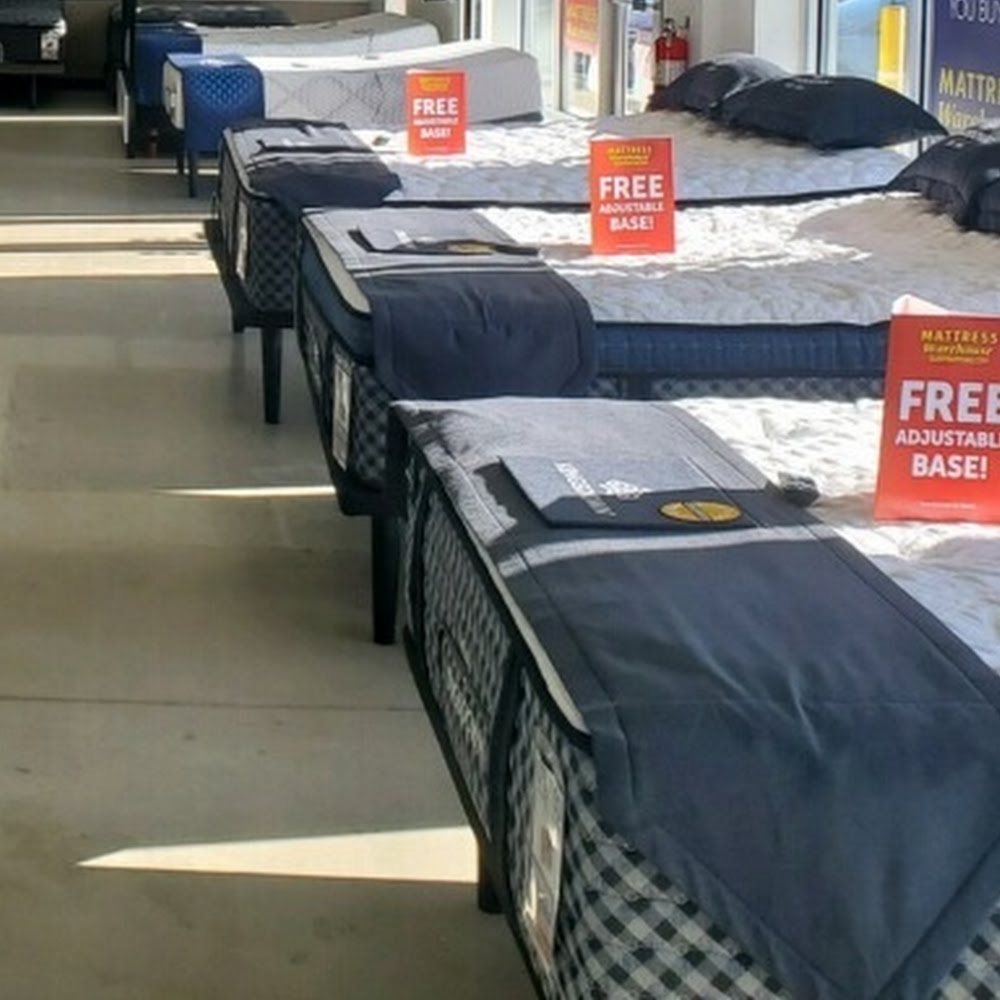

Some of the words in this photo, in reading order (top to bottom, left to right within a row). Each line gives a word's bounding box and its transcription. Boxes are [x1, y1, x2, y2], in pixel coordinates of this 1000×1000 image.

[938, 67, 1000, 106] MATTR
[412, 97, 459, 115] FREE
[599, 174, 664, 199] FREE
[609, 215, 655, 231] BASE!
[921, 329, 998, 344] MATTRESS
[895, 429, 1000, 448] ADJUSTABL
[911, 453, 989, 479] BASE!
